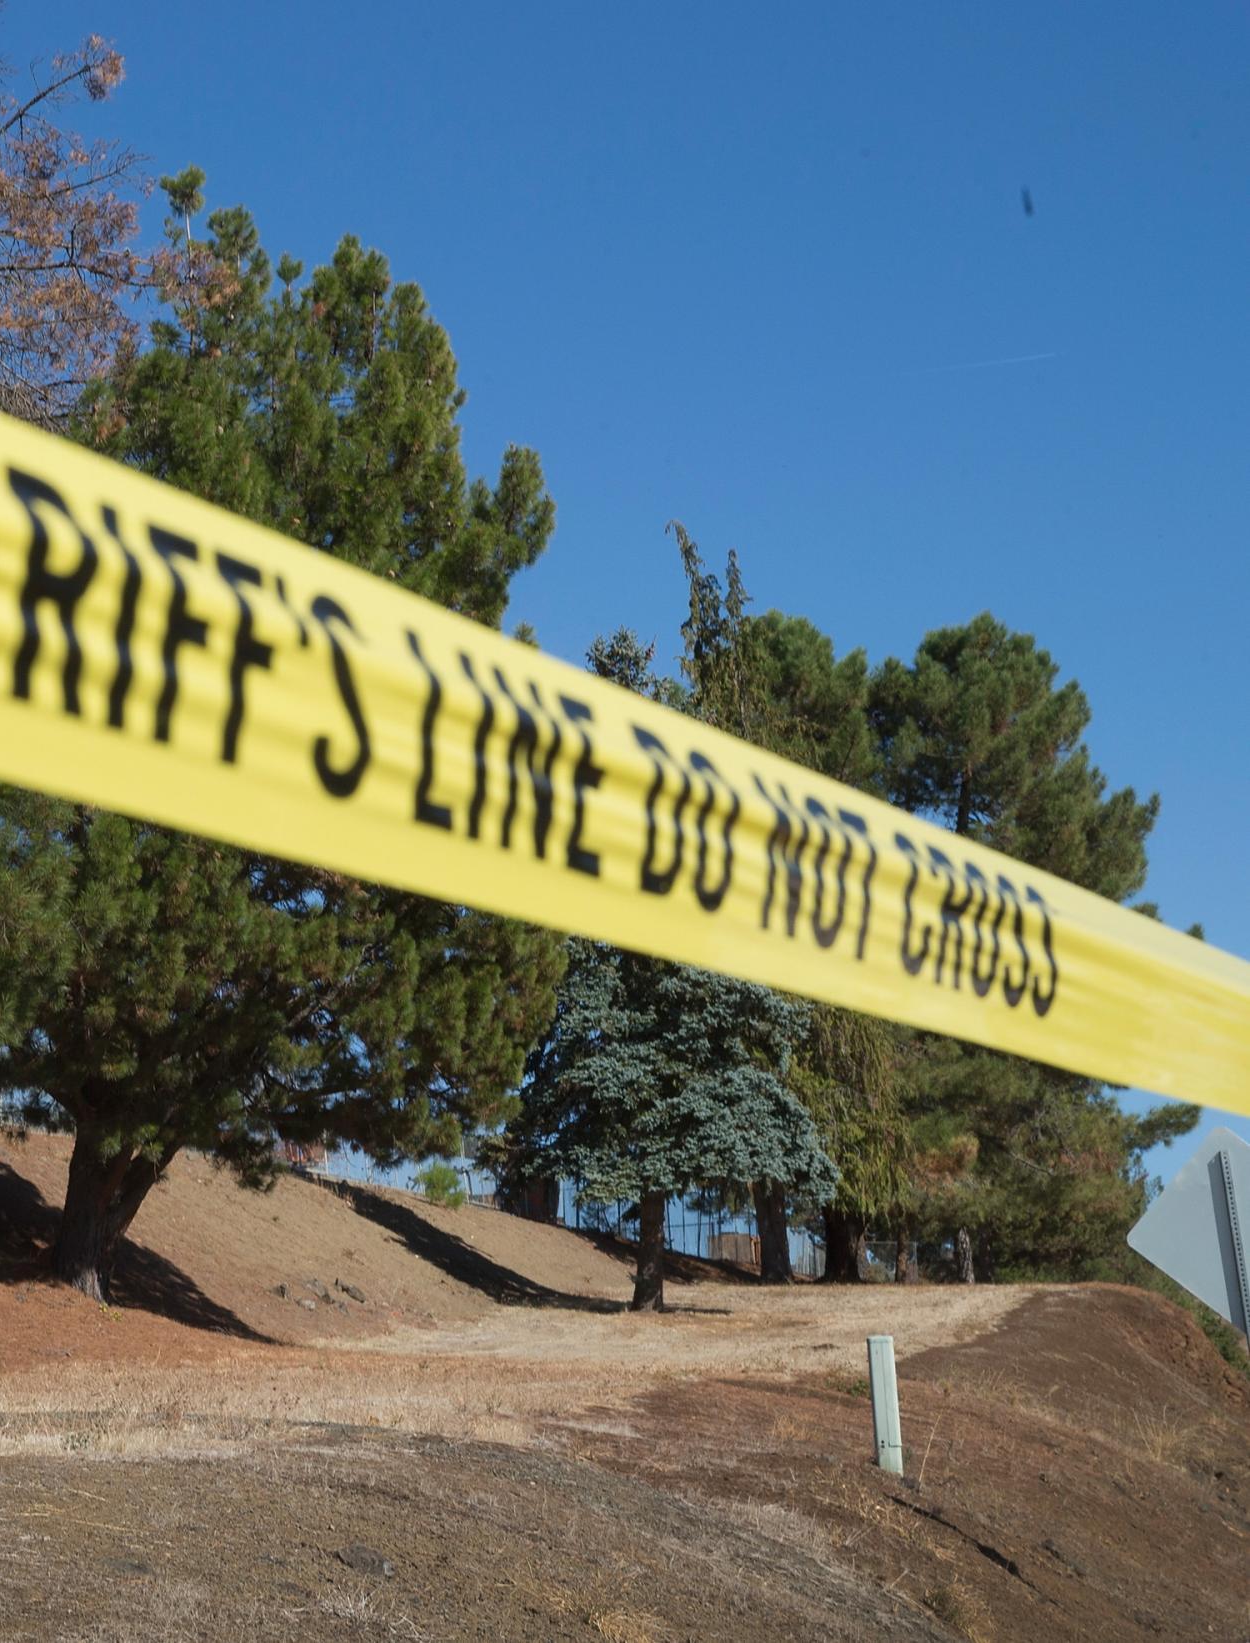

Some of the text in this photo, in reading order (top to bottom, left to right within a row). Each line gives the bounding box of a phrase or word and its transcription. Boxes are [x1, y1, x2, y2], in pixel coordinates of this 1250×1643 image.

[406, 628, 602, 878] LINE
[631, 724, 741, 912] DO
[751, 771, 877, 962] NOT
[893, 832, 1059, 1018] CROSS
